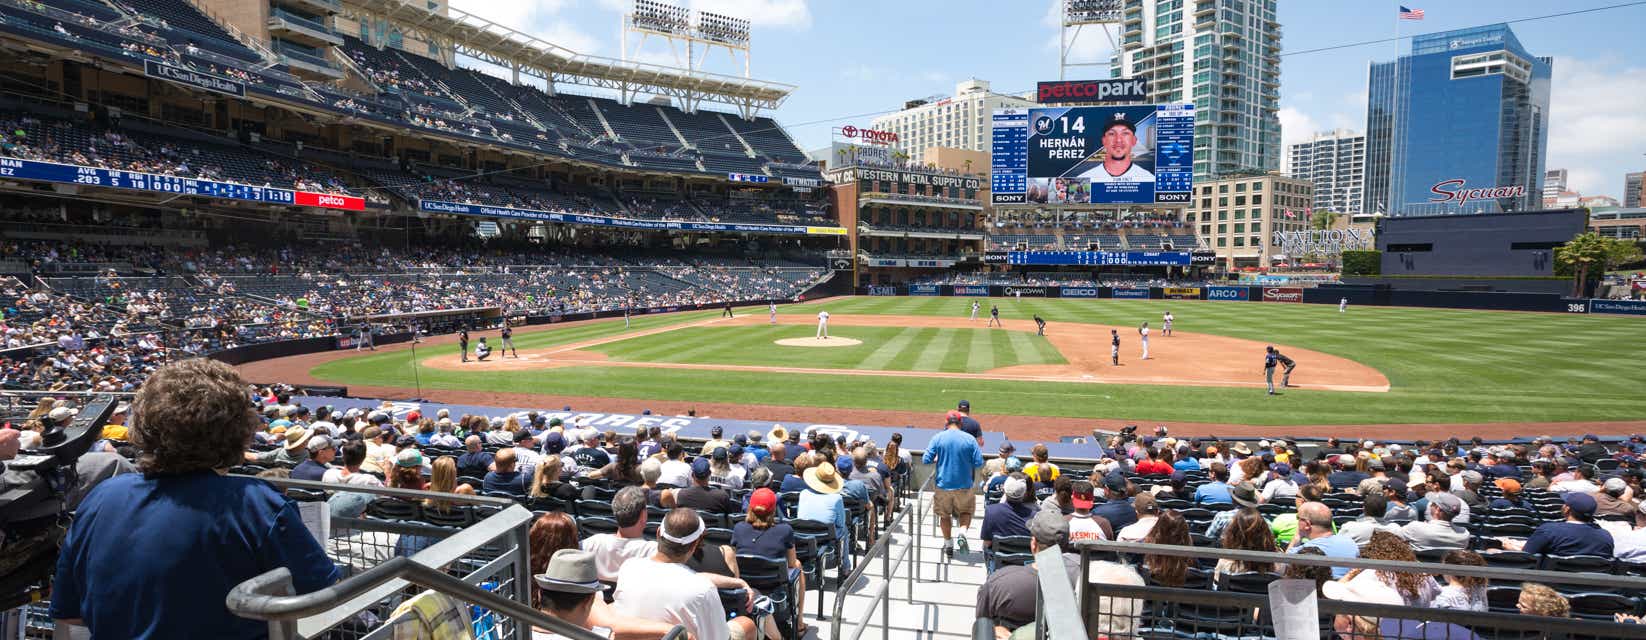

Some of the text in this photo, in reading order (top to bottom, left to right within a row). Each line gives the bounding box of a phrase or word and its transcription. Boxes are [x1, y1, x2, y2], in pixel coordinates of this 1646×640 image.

[158, 65, 237, 92] UC San Diego Health
[1061, 116, 1085, 133] 14
[860, 128, 898, 143] TOYOTA
[1040, 136, 1085, 148] HERNÁN
[857, 146, 888, 161] PADRES
[1049, 147, 1085, 159] PÉREZ
[77, 167, 97, 175] AVG
[108, 170, 121, 178] HR
[128, 172, 143, 180] RBI
[112, 178, 119, 186] 5
[132, 180, 144, 188] 18
[787, 177, 818, 187] CUTWATER
[857, 168, 978, 189] WESTERN METAL SUPPLY CO.
[255, 192, 260, 200] 3
[268, 190, 291, 201] 1:19
[1428, 178, 1528, 208] Sycuan
[318, 194, 345, 206] petco
[1062, 288, 1096, 296] GEICO
[1209, 289, 1237, 298] ARCO
[1567, 303, 1585, 312] 396
[638, 445, 650, 459] 4
